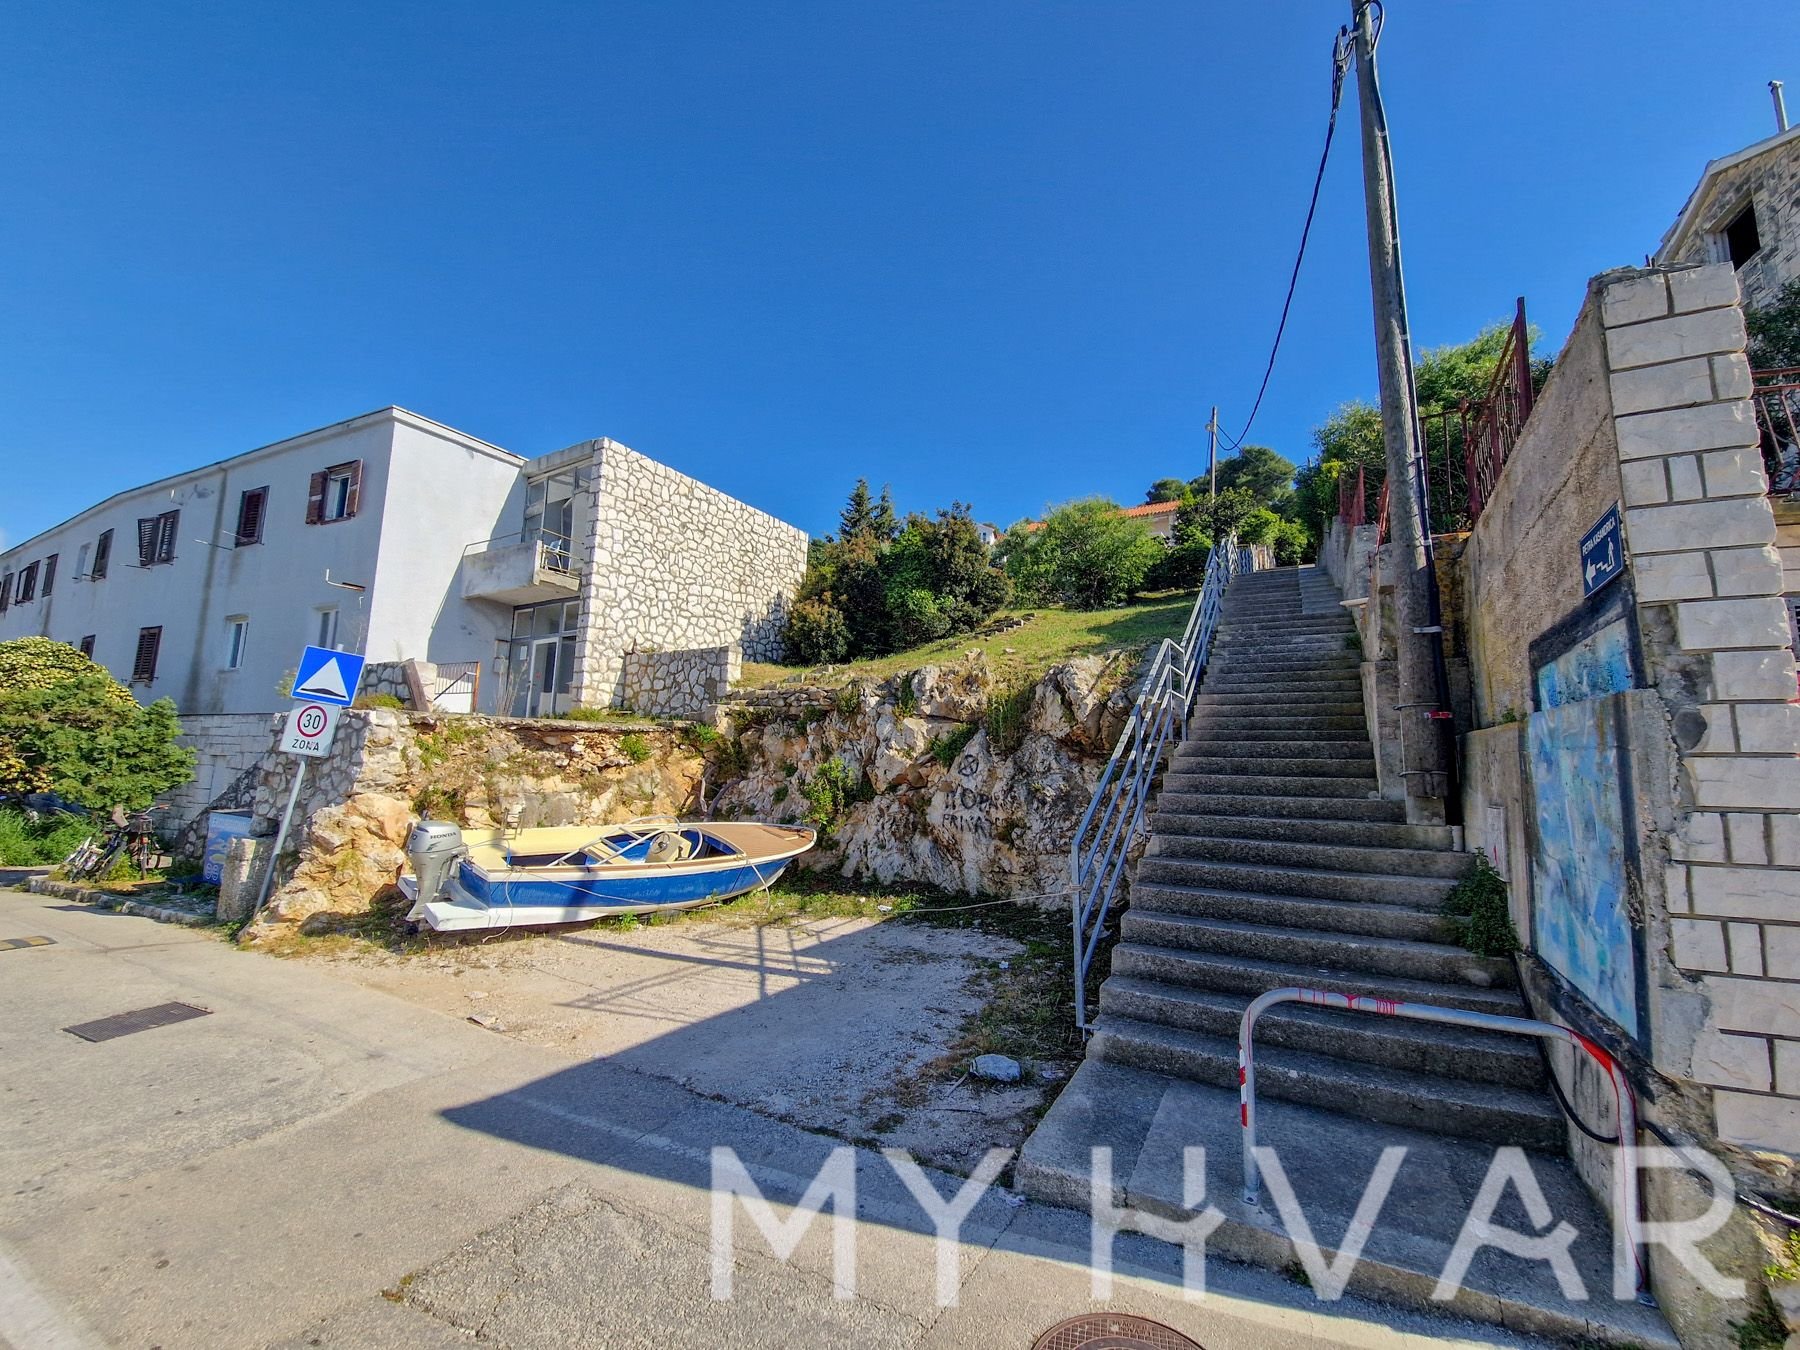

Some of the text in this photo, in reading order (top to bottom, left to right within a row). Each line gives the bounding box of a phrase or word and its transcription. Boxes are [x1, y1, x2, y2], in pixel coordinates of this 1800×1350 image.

[303, 713, 321, 730] 30
[291, 738, 320, 752] ZONA
[430, 831, 457, 840] HONDA
